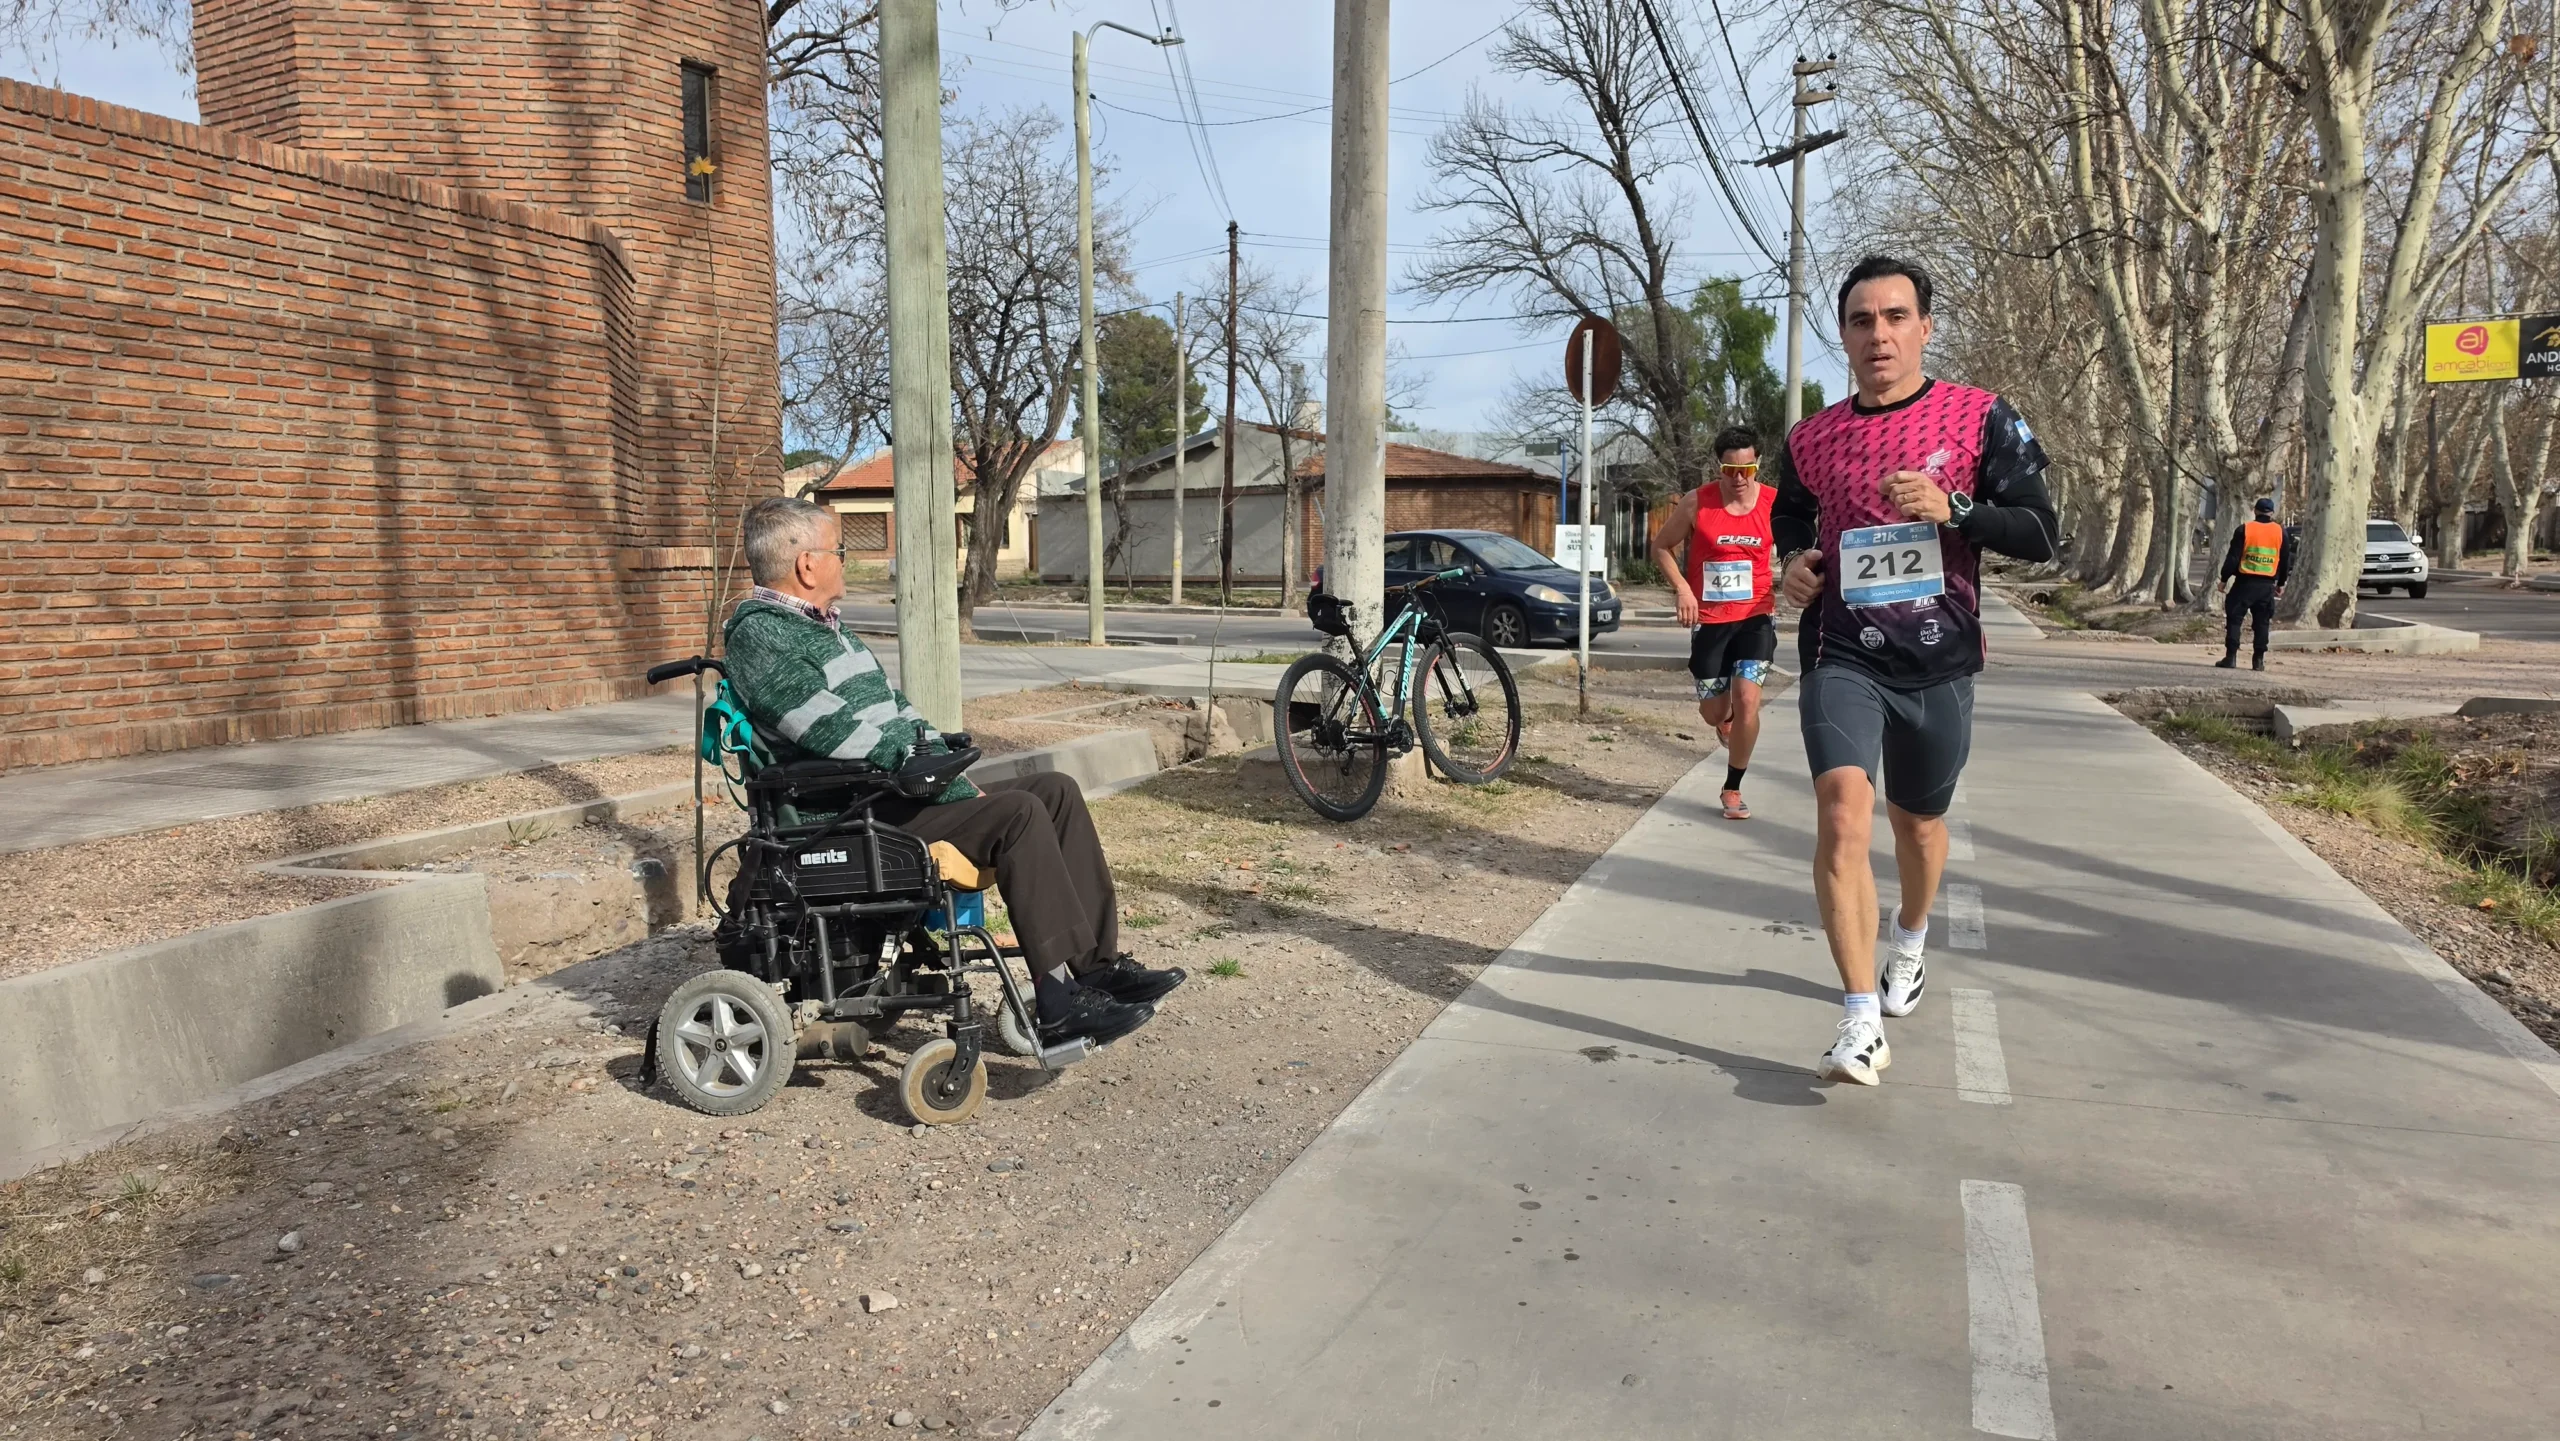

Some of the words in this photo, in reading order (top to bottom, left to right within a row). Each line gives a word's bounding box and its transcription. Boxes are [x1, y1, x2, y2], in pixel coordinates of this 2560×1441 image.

[2525, 351, 2560, 364] AND
[1716, 534, 1762, 545] PUSH
[1872, 530, 1899, 544] 21K
[1857, 549, 1924, 580] 212
[1711, 574, 1741, 588] 421
[800, 849, 847, 865] merits
